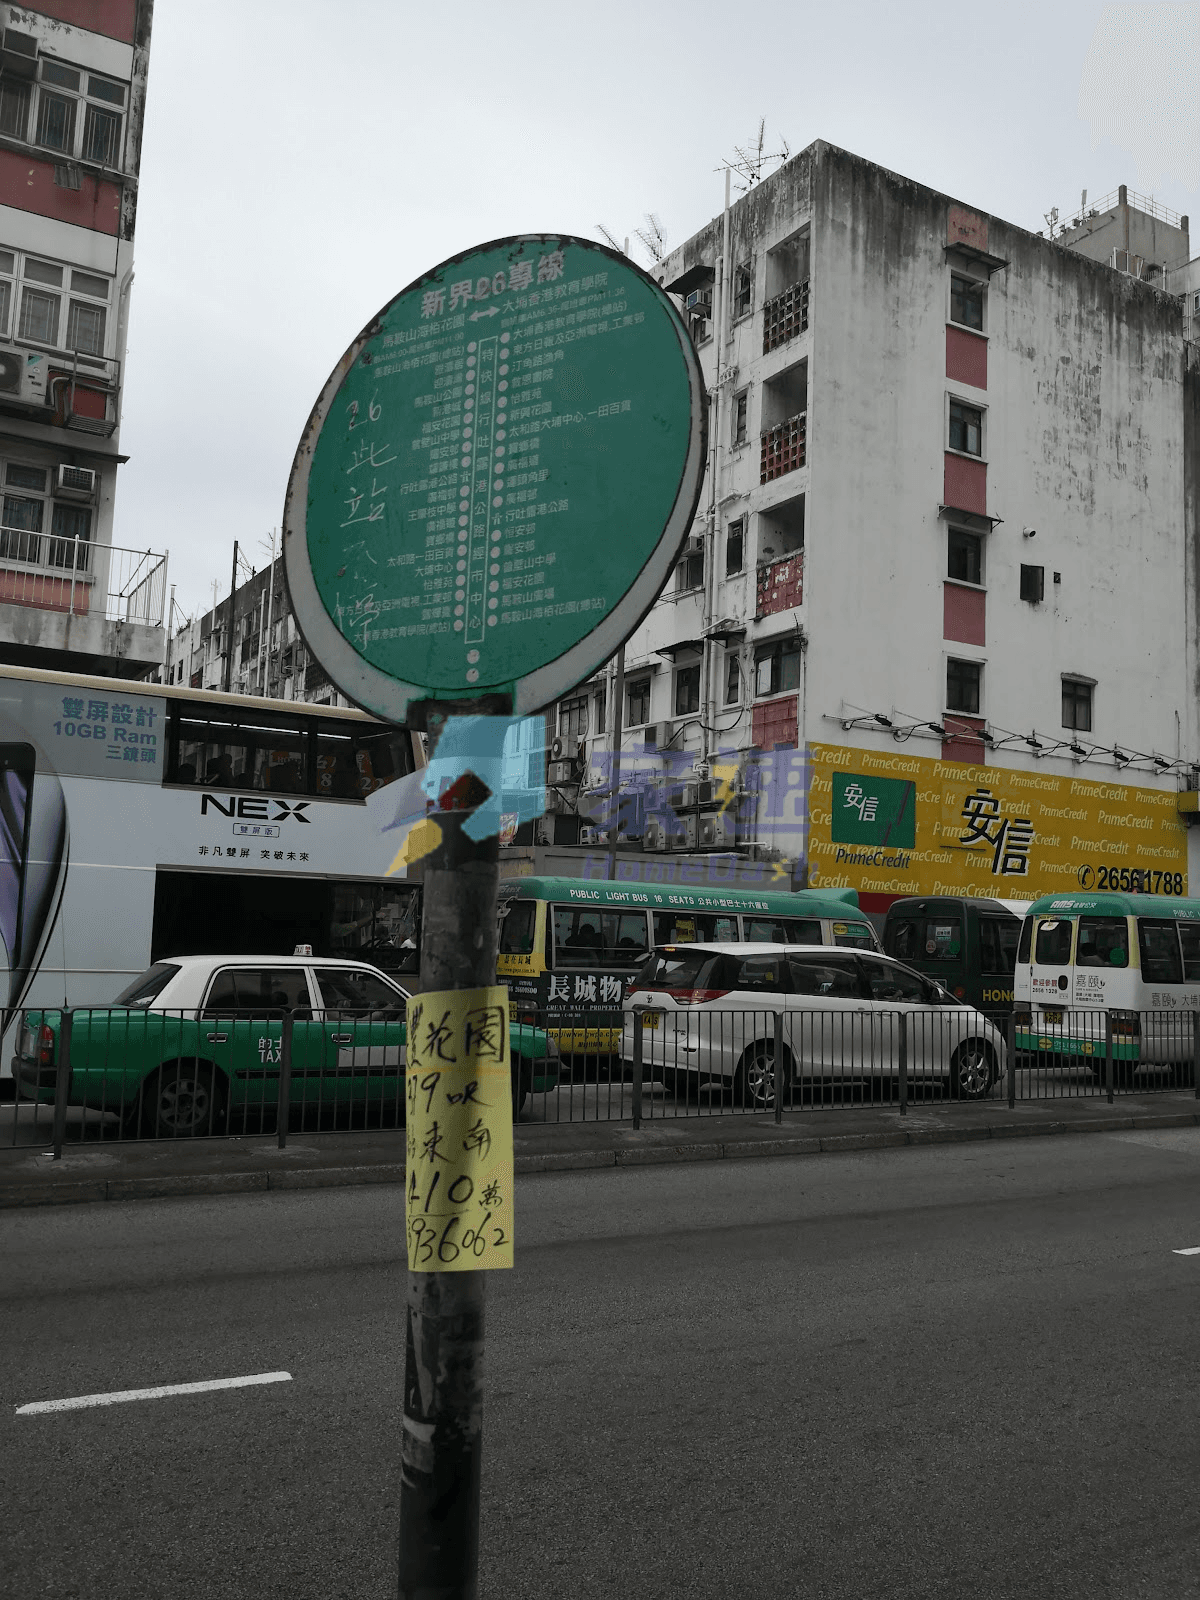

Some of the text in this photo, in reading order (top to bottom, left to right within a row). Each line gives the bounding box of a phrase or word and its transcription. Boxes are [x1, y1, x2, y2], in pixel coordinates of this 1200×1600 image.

[345, 388, 382, 431] 26
[61, 696, 158, 728] 雙屏設計
[53, 720, 157, 746] 10GB Ram
[105, 744, 157, 764] 三鏡頭
[862, 753, 921, 774] PrimeCredit
[932, 762, 1001, 786] PrimeCredit
[1009, 773, 1060, 792] PrimeCredit
[1070, 780, 1129, 802] PrimeCredit
[200, 793, 312, 824] NEX
[843, 783, 880, 822] 安信
[1039, 804, 1089, 821] PrimeCredit
[1098, 809, 1155, 830] PrimeCredit
[239, 825, 273, 836] 雙屏版
[959, 788, 1037, 876] 安信
[198, 845, 310, 862] 非凡雙屏 突破未來
[1071, 835, 1130, 855] PrimeCredit
[1136, 843, 1180, 860] PrimeCredit
[835, 848, 911, 870] PrimeCredit
[860, 876, 920, 894] PrimeCredit
[932, 881, 1001, 899] PrimeCredit
[569, 889, 695, 905] PUBLIC LIGHT BUS 16 SEATS
[547, 974, 638, 1002] 長城物
[1181, 994, 1200, 1007] 大埔
[258, 1050, 282, 1063] TAX
